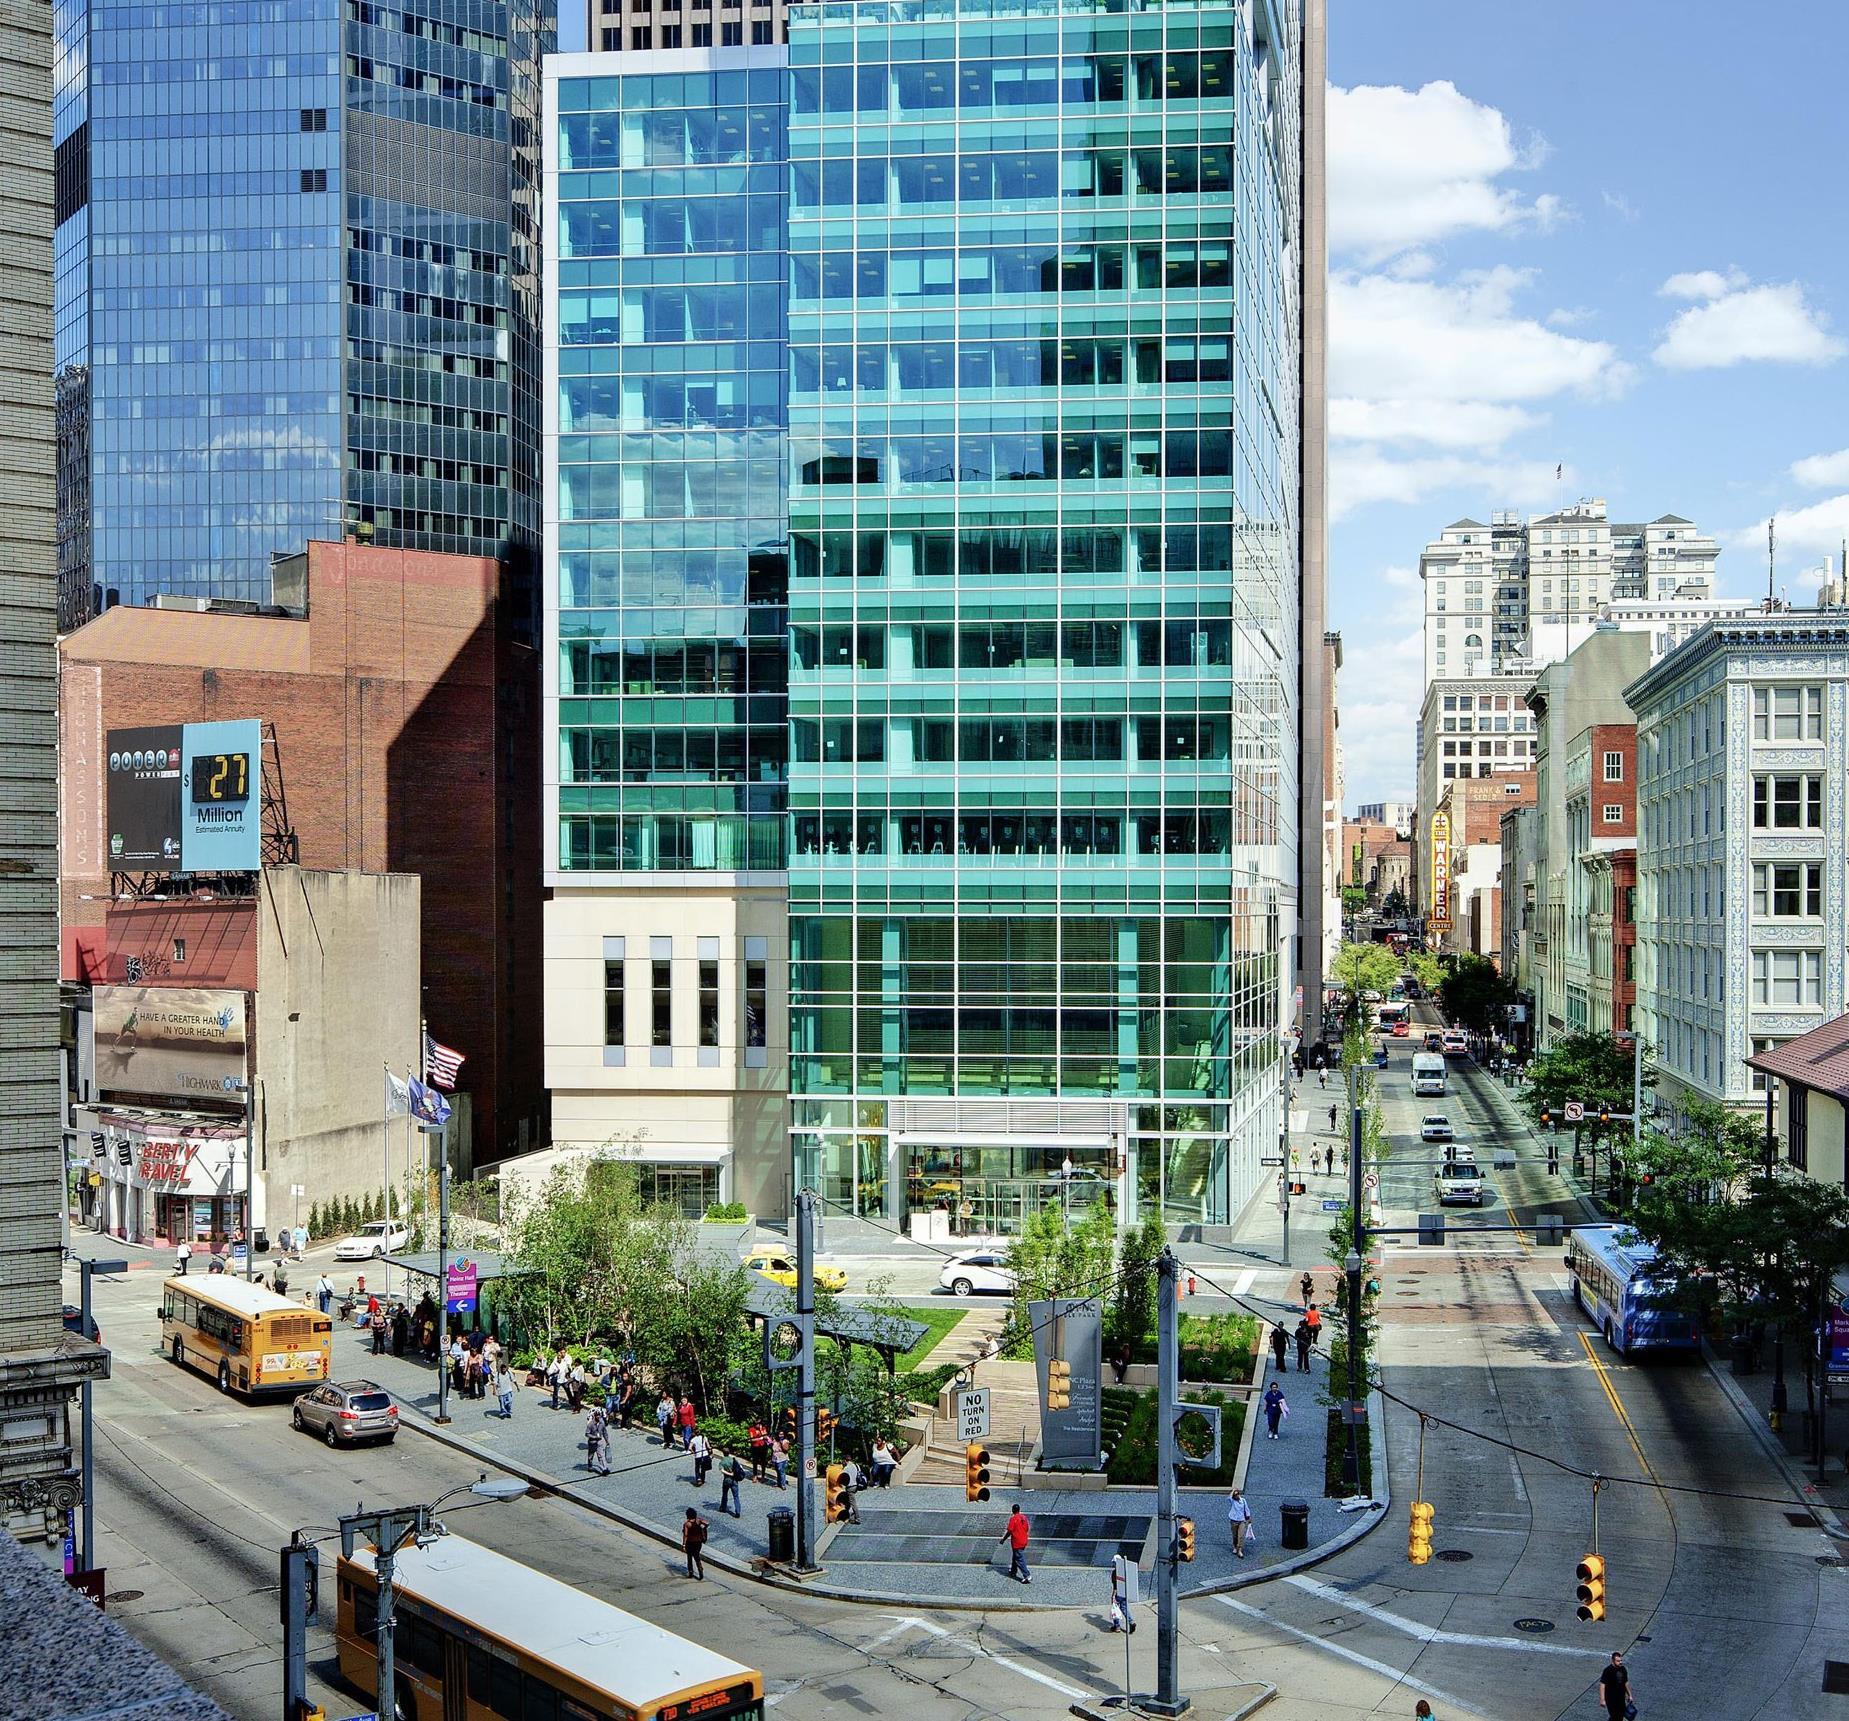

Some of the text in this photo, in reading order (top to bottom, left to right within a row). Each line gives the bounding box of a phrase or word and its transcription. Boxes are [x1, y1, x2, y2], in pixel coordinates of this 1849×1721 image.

[110, 750, 167, 771] POWER
[183, 754, 246, 799] $ 27
[1469, 786, 1494, 794] FRANK
[197, 807, 243, 823] Million
[195, 825, 246, 834] Estimated Annuity
[1435, 840, 1447, 919] WARNER
[1429, 922, 1452, 930] CENTRE
[140, 1012, 225, 1026] HAVE A GREATER HAND
[163, 1026, 225, 1038] IN YOUR HEALTH
[966, 1394, 982, 1406] NO
[962, 1405, 985, 1417] TURN
[968, 1415, 980, 1425] ON
[965, 1425, 982, 1436] RED
